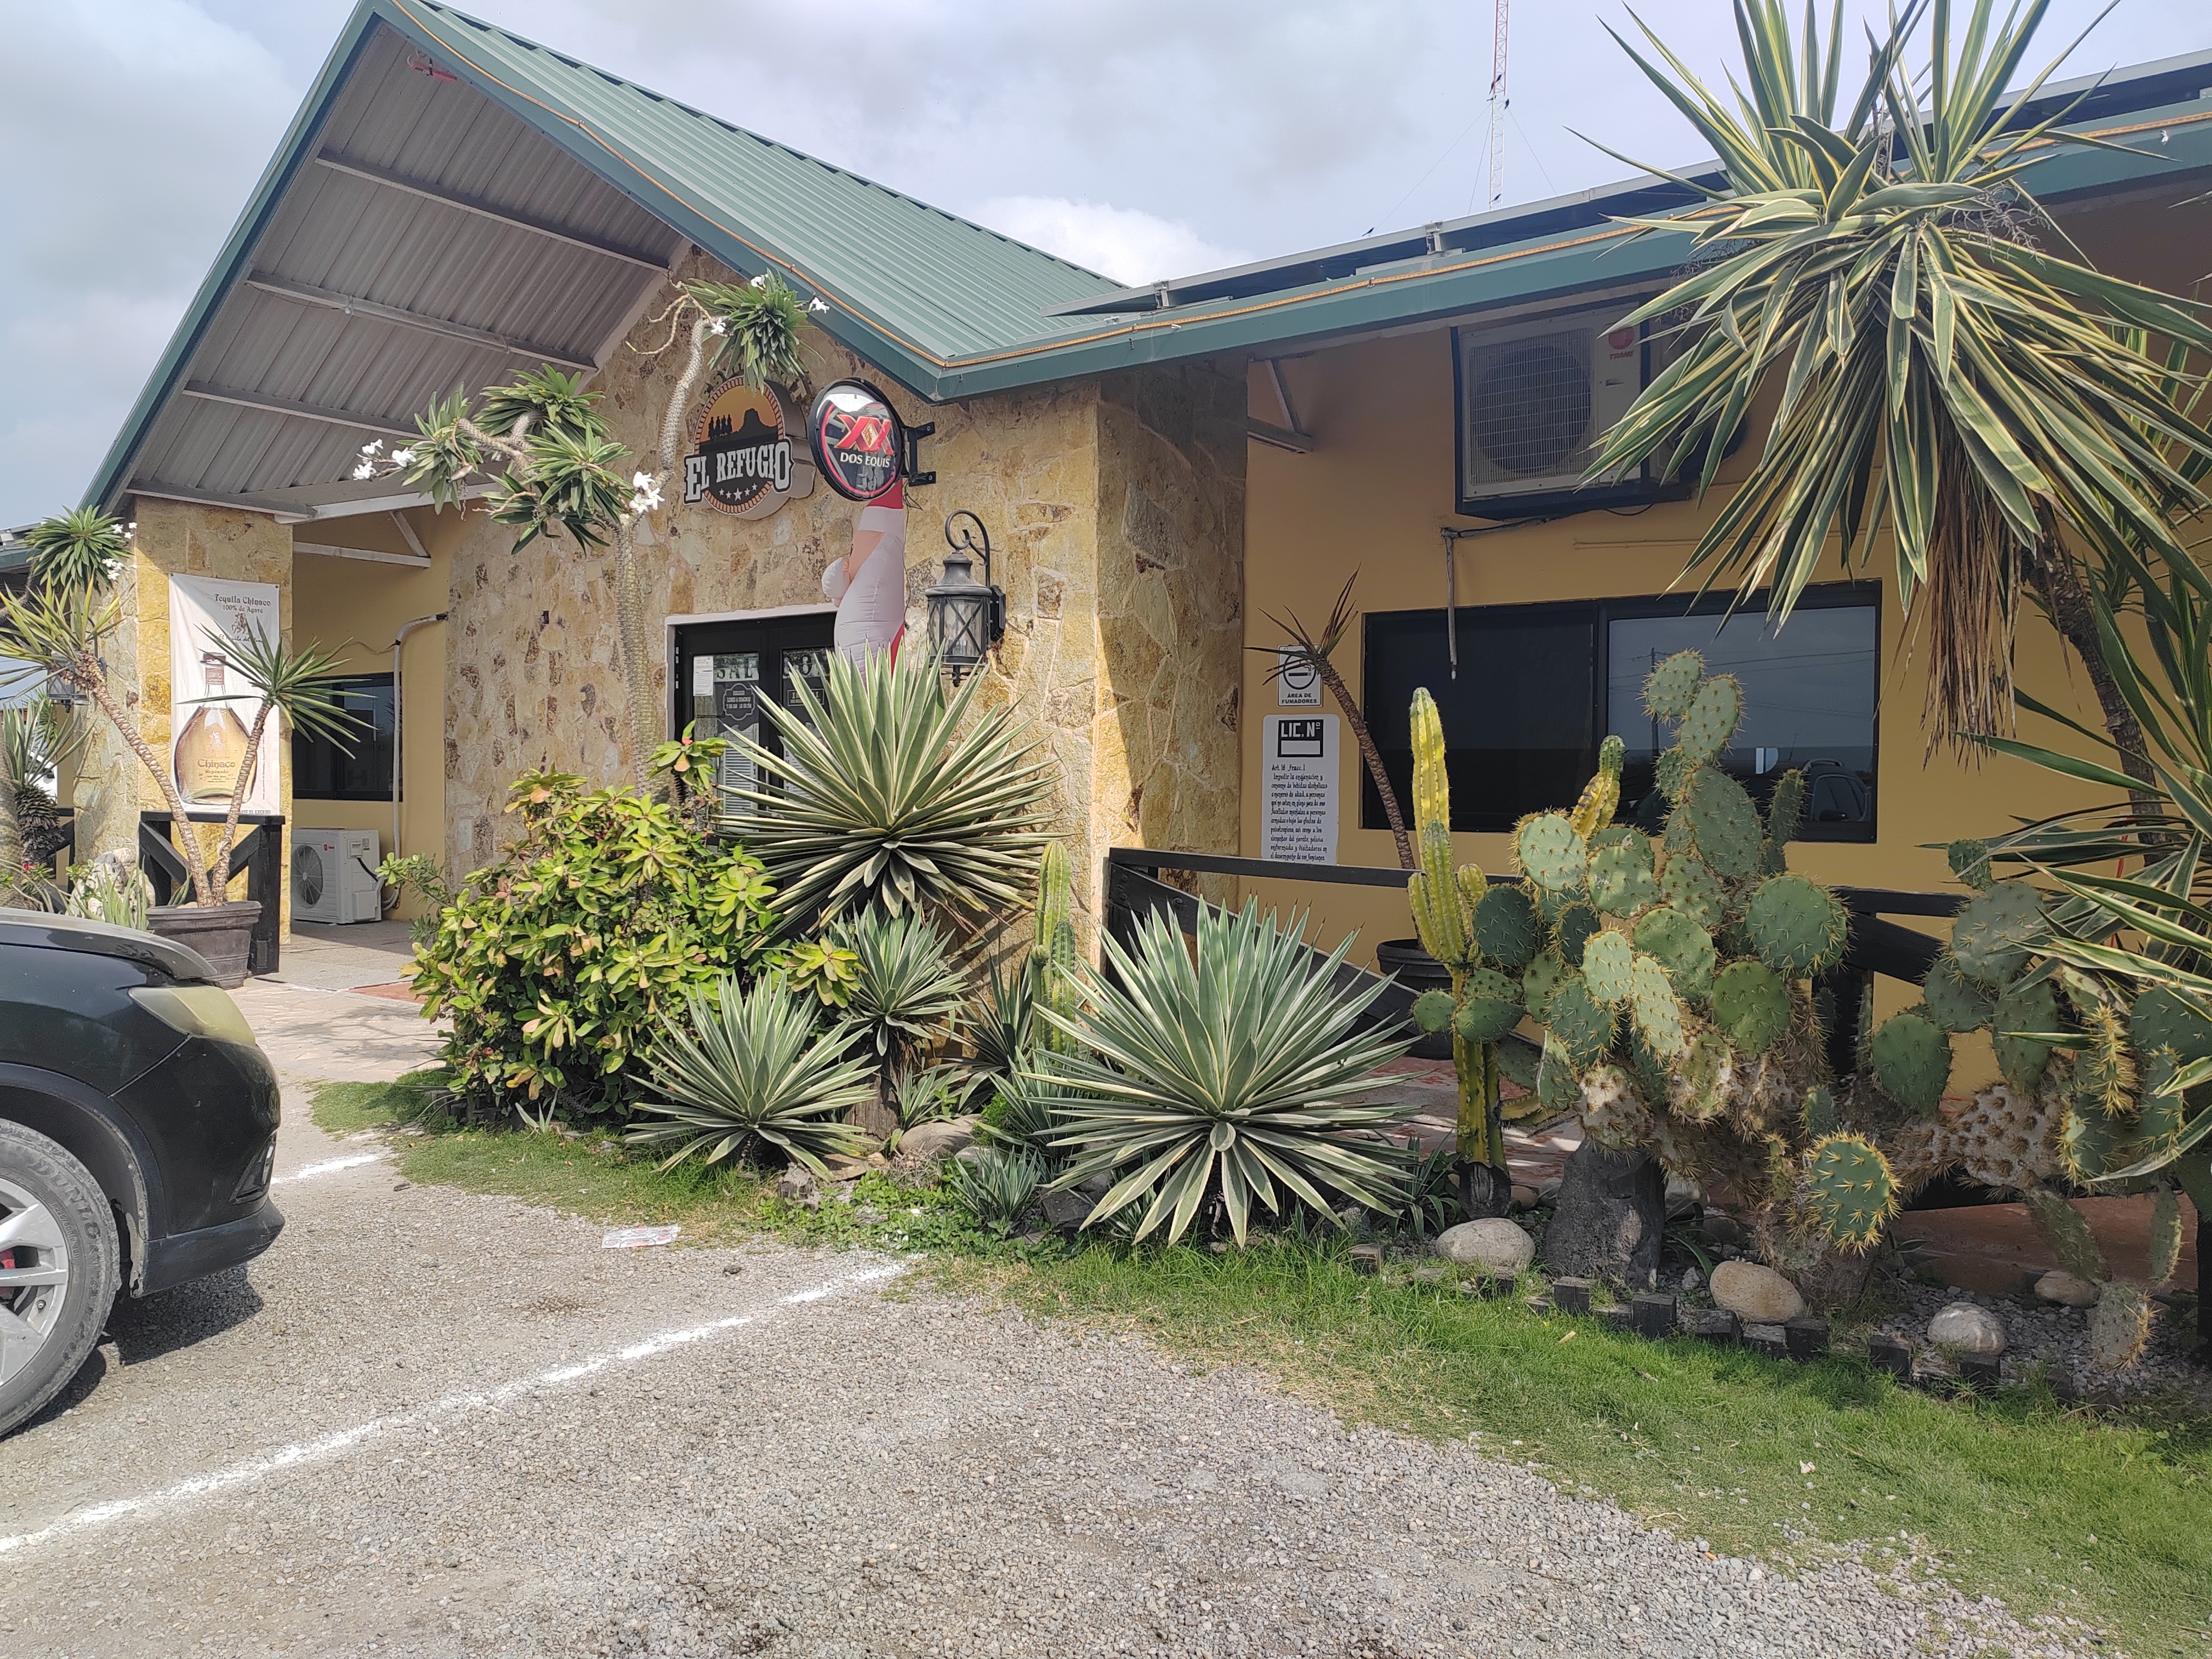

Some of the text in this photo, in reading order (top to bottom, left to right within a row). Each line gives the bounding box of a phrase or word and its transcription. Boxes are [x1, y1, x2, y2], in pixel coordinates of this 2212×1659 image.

[1610, 350, 1634, 360] TRANE
[840, 452, 891, 468] DOS EQUIS
[686, 442, 792, 501] EL REFUGIO
[214, 594, 271, 606] Tequila Chinaco
[1281, 723, 1304, 738] LIC.
[198, 759, 235, 770] Chinaco
